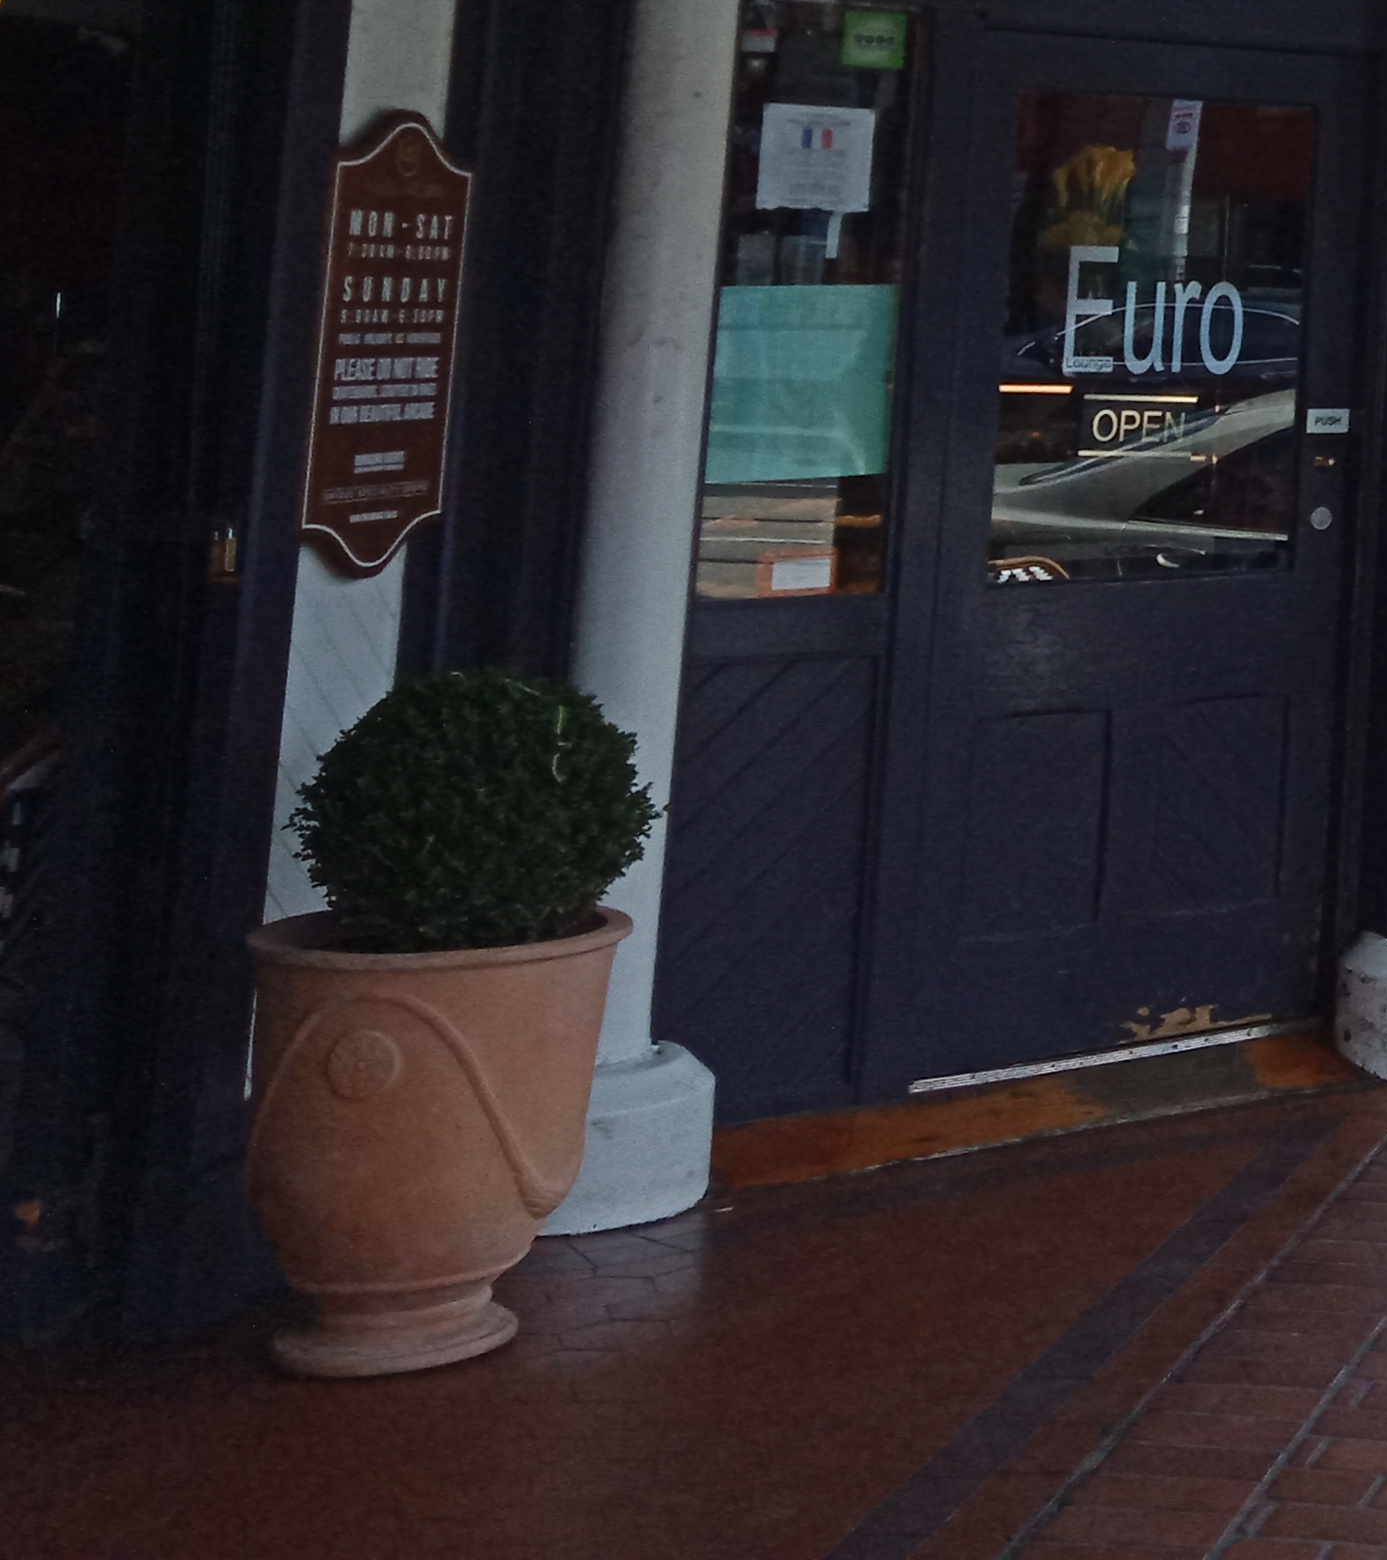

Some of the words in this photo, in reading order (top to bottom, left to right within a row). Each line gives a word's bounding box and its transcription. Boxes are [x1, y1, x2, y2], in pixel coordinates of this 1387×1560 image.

[349, 209, 395, 237] MON
[416, 213, 454, 240] SAT
[342, 276, 447, 303] SUNDAY
[1063, 246, 1243, 375] Euro
[1092, 409, 1186, 443] OPEN
[1314, 415, 1342, 427] PUSH
